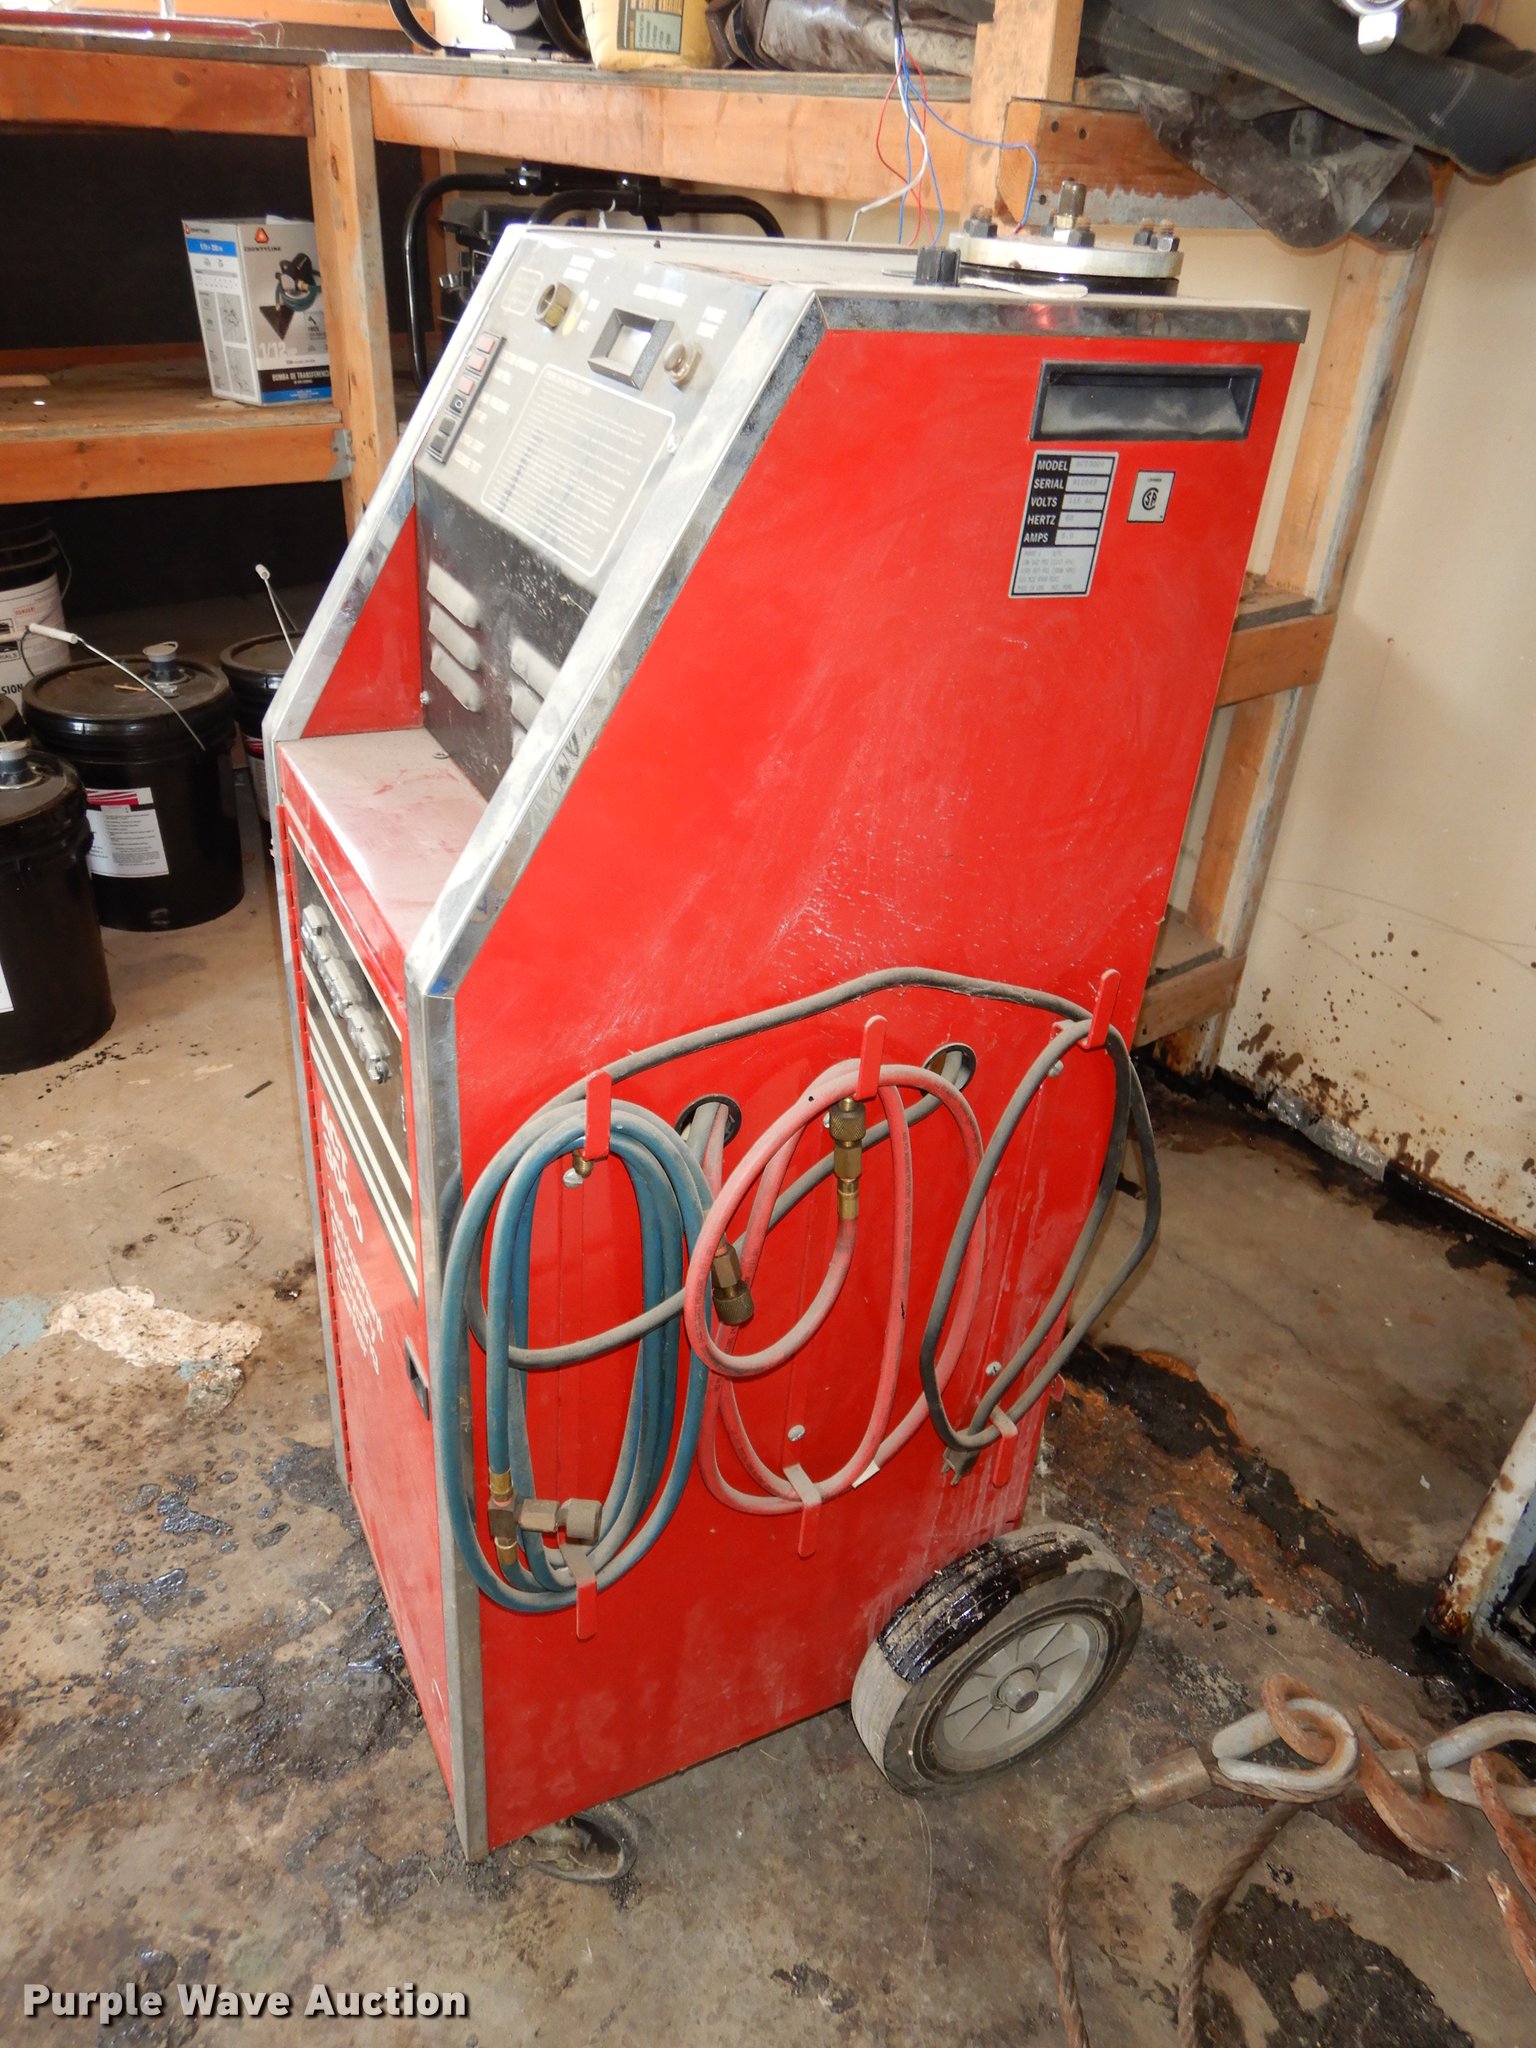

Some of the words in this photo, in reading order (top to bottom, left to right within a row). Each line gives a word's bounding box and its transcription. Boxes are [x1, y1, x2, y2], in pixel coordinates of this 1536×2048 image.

[1037, 460, 1068, 471] MODEL
[1033, 478, 1064, 490] SERIAL
[1030, 496, 1058, 507] VOLTS
[1027, 515, 1056, 525] HERTZ
[1023, 532, 1048, 543] AMPS
